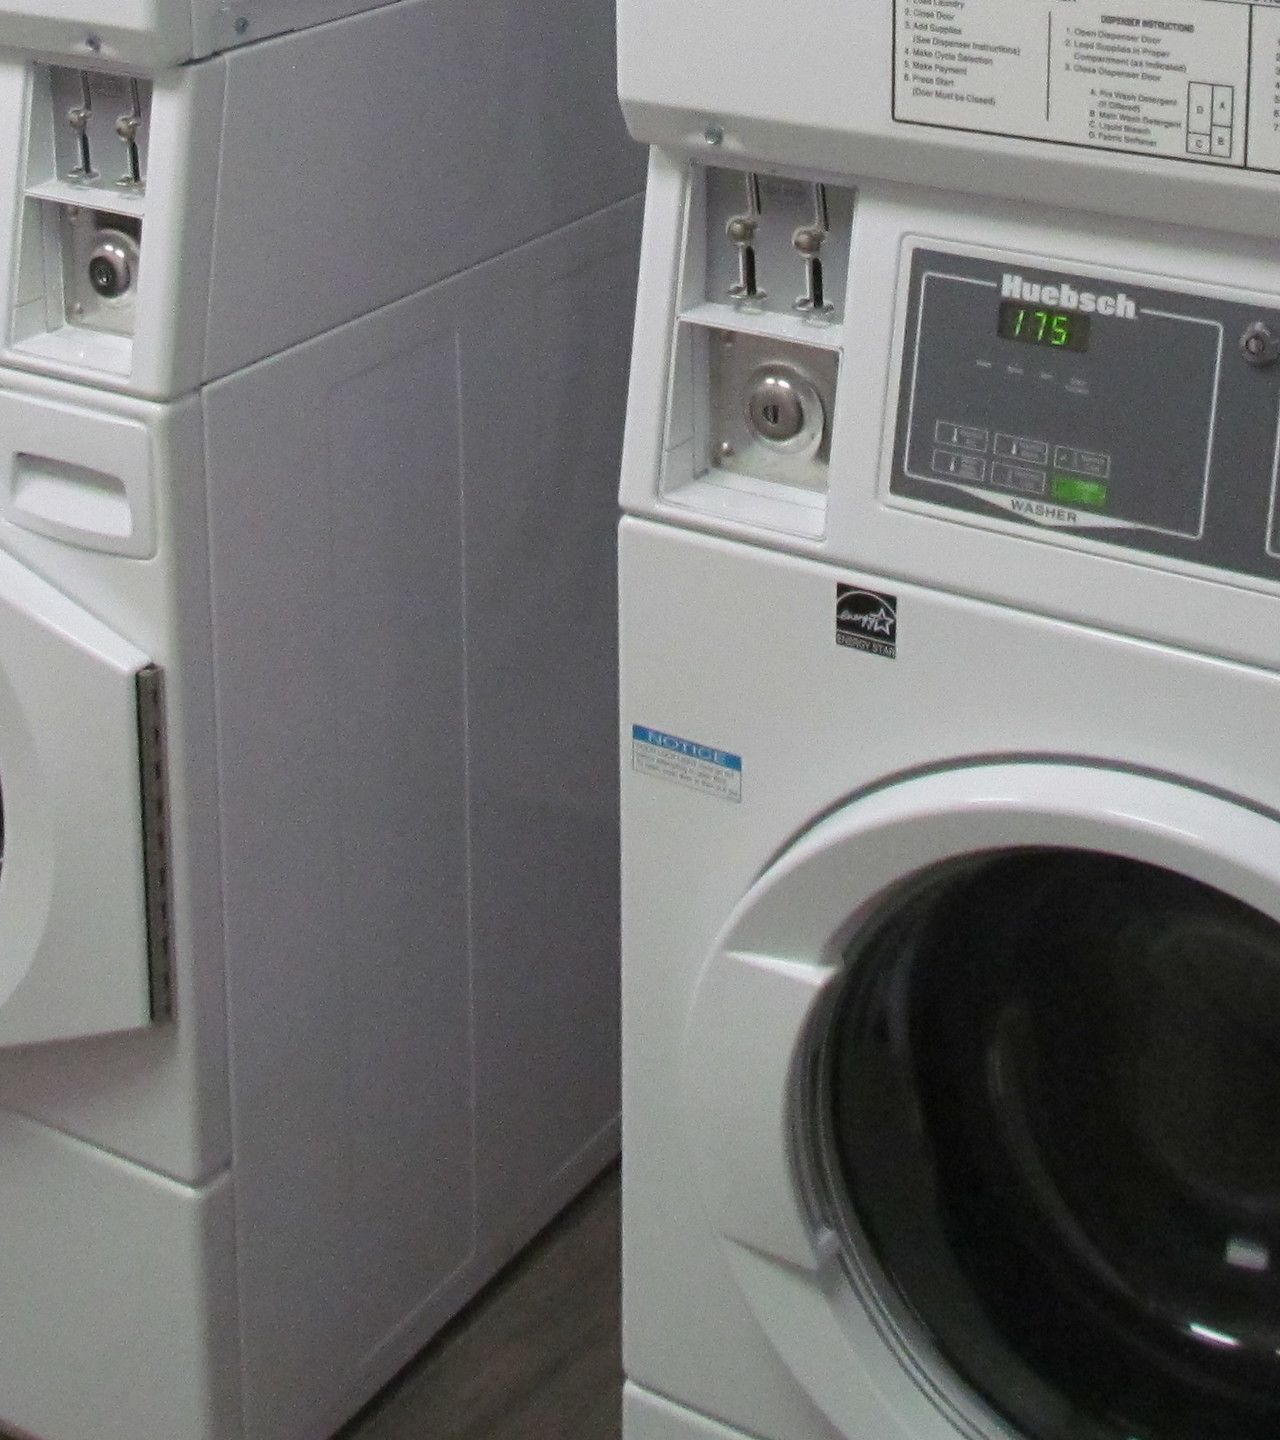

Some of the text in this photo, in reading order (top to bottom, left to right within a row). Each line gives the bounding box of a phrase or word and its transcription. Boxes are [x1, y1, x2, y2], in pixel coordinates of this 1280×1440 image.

[1195, 139, 1203, 149] C
[1001, 273, 1139, 320] Huebsch
[1014, 309, 1068, 346] 175
[1010, 498, 1078, 524] WASHER
[648, 731, 727, 764] NOTICE
